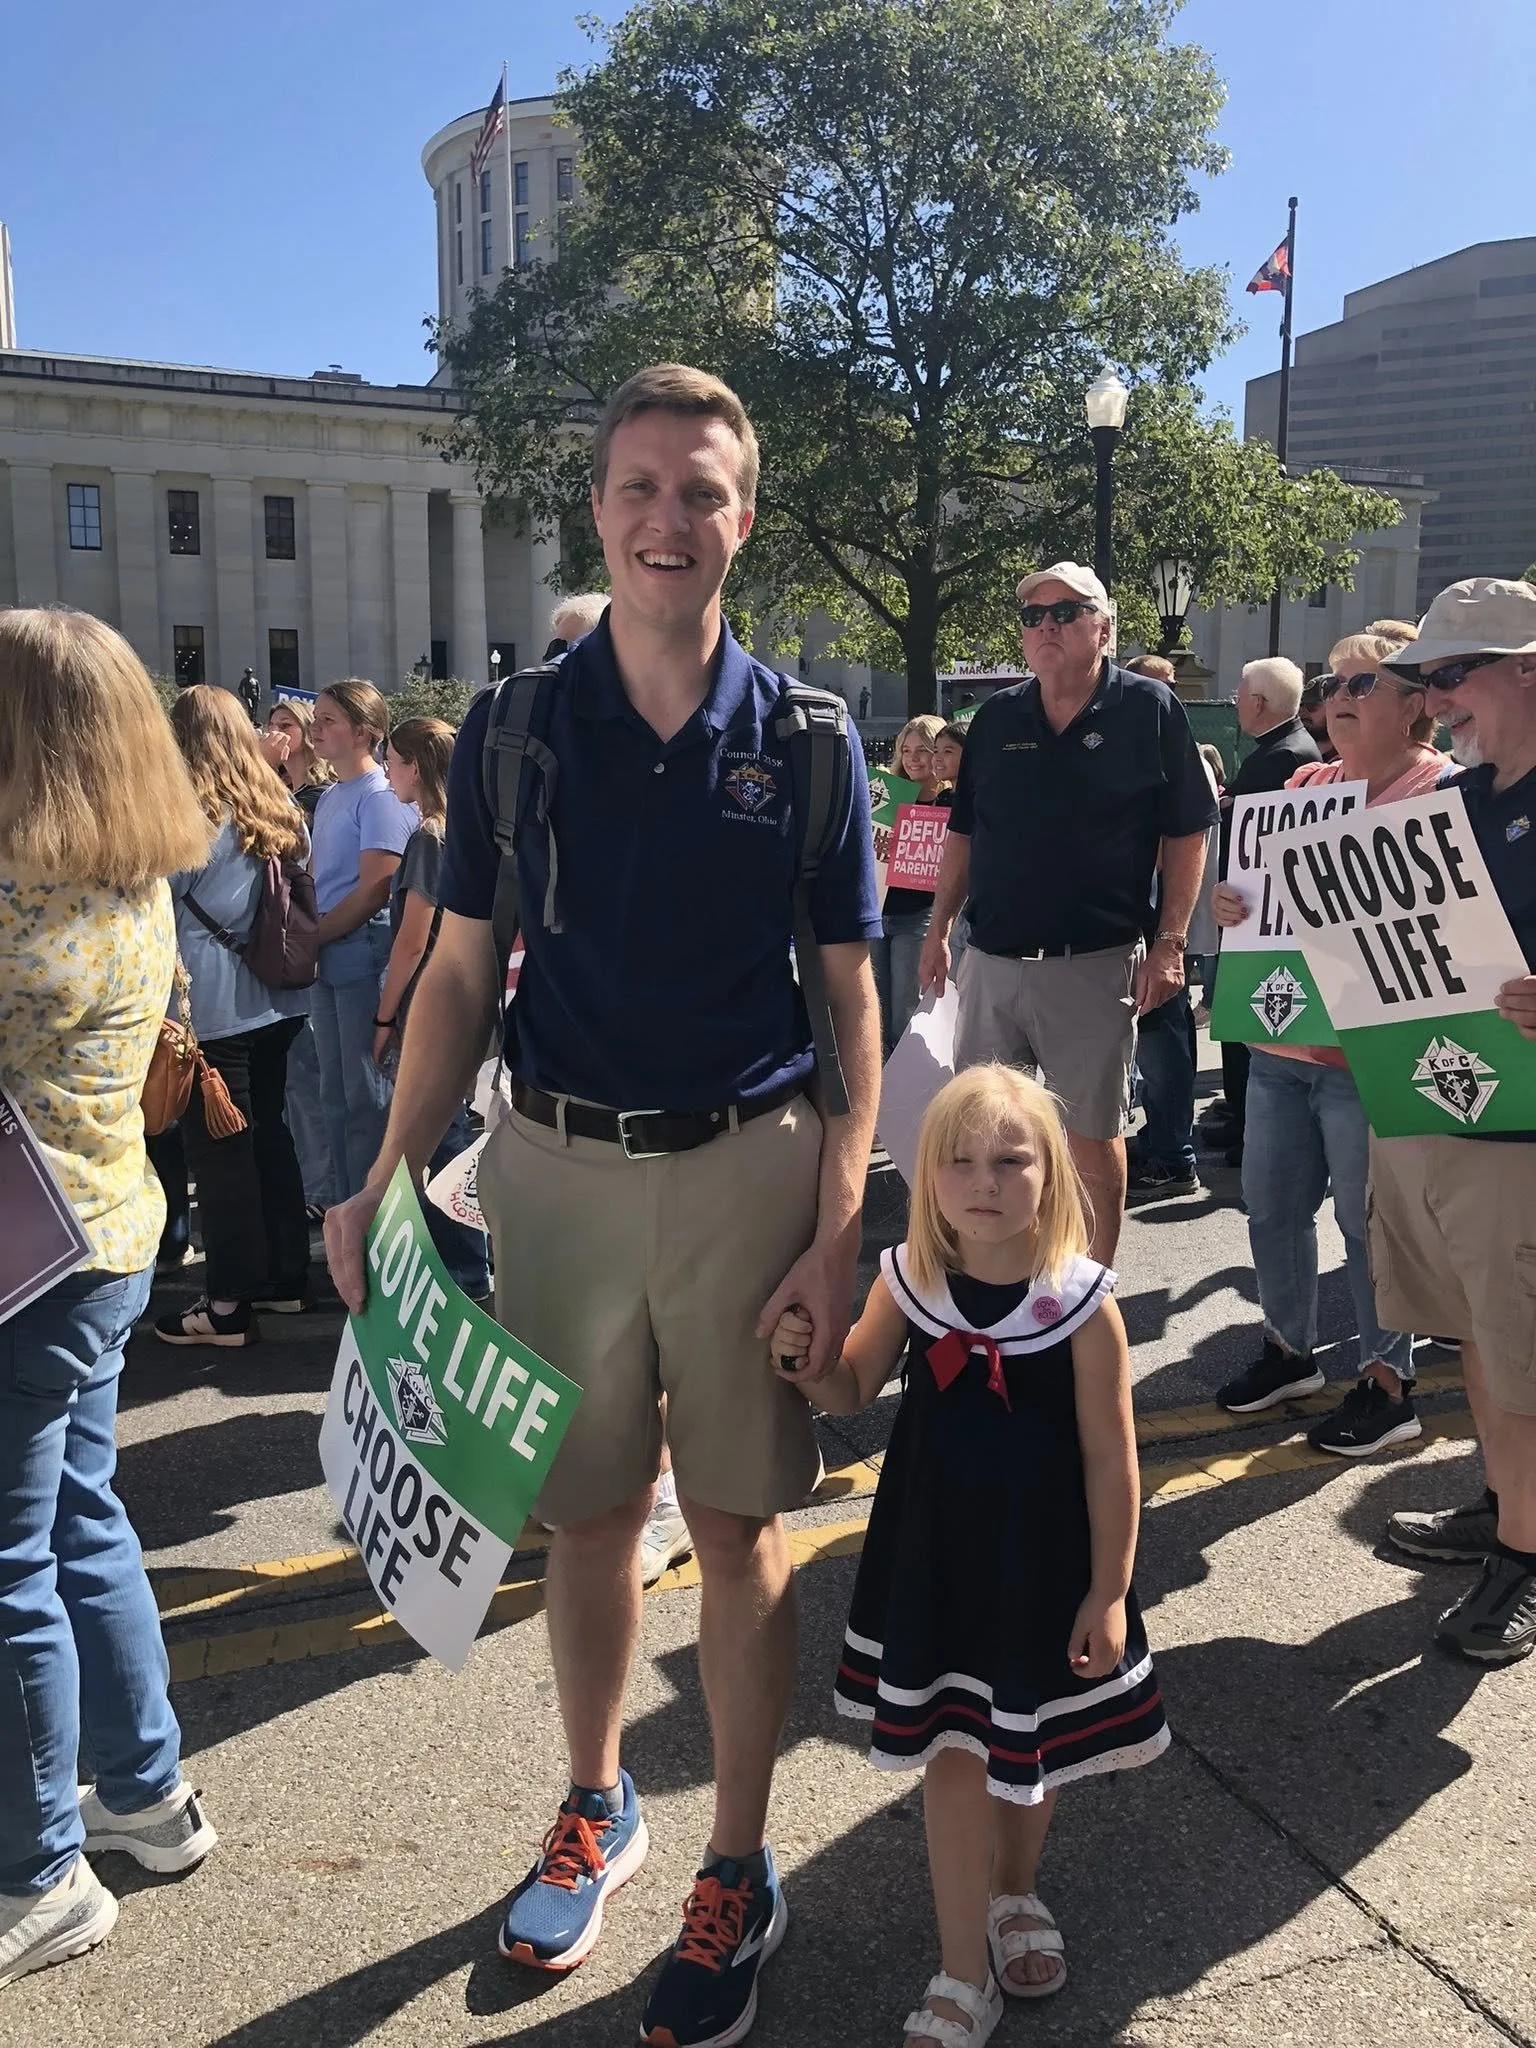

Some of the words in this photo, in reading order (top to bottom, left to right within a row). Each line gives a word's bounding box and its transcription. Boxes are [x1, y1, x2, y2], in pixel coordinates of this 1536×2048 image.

[959, 665, 998, 676] MARCH
[720, 748, 760, 761] Council
[757, 815, 777, 826] Ohio
[1282, 811, 1478, 928] CHOOSE
[1352, 913, 1467, 1005] LIFE
[1266, 982, 1273, 992] K
[1286, 983, 1294, 993] C
[1428, 1058, 1441, 1071] K
[1441, 1057, 1455, 1068] OF
[1458, 1055, 1470, 1067] C
[369, 1186, 447, 1363] LOVE
[442, 1318, 561, 1462] LIFE
[424, 1395, 433, 1410] C
[343, 1358, 481, 1588] CHOOSE
[343, 1465, 412, 1606] LIFE
